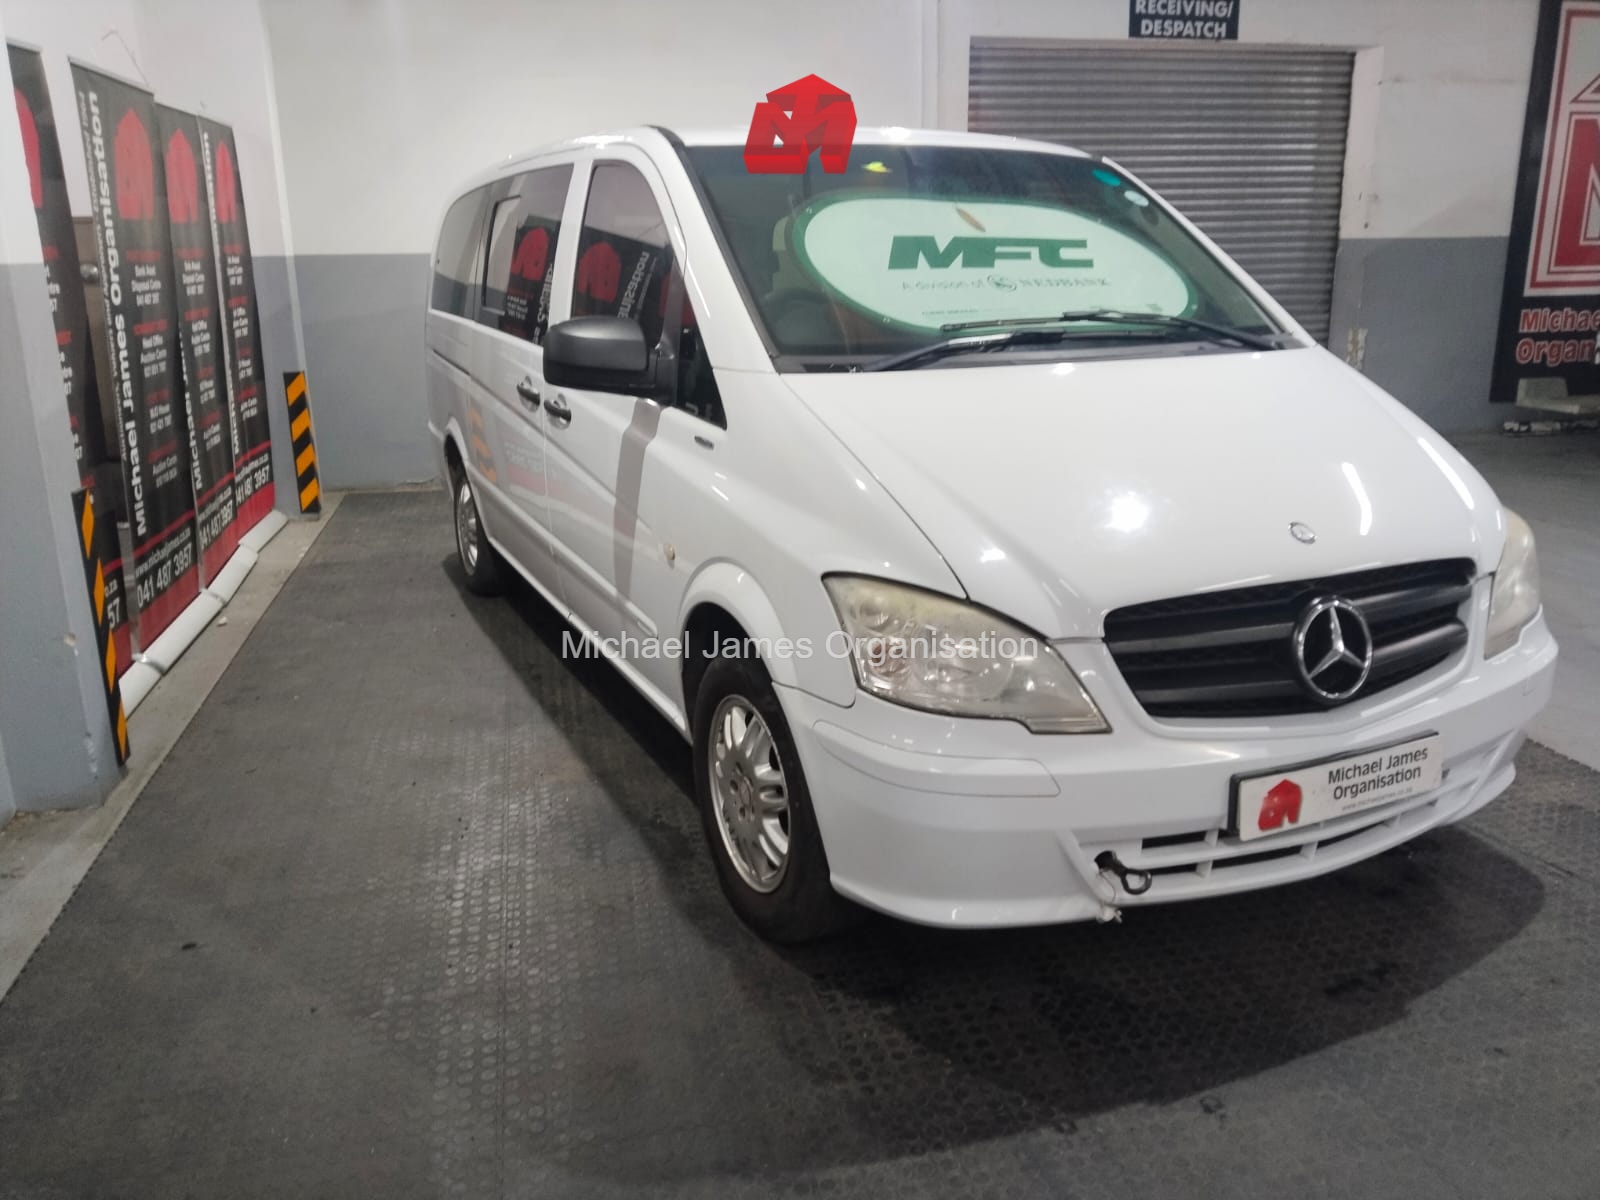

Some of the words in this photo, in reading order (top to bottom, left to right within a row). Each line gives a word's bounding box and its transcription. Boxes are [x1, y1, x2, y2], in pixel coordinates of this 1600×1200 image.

[1136, 0, 1234, 18] RECEIVING/
[1141, 19, 1227, 38] DESPATCH
[89, 91, 122, 306] Organisation
[888, 235, 1094, 270] MFC
[1519, 306, 1600, 333] Michae
[115, 313, 134, 413] James
[184, 391, 203, 491] Michael
[125, 420, 147, 537] Michael
[136, 576, 154, 608] 041
[156, 563, 172, 591] 487
[173, 542, 193, 577] 3957
[1328, 757, 1383, 785] Michael
[1386, 747, 1428, 770] James
[1333, 766, 1422, 800] Organisation
